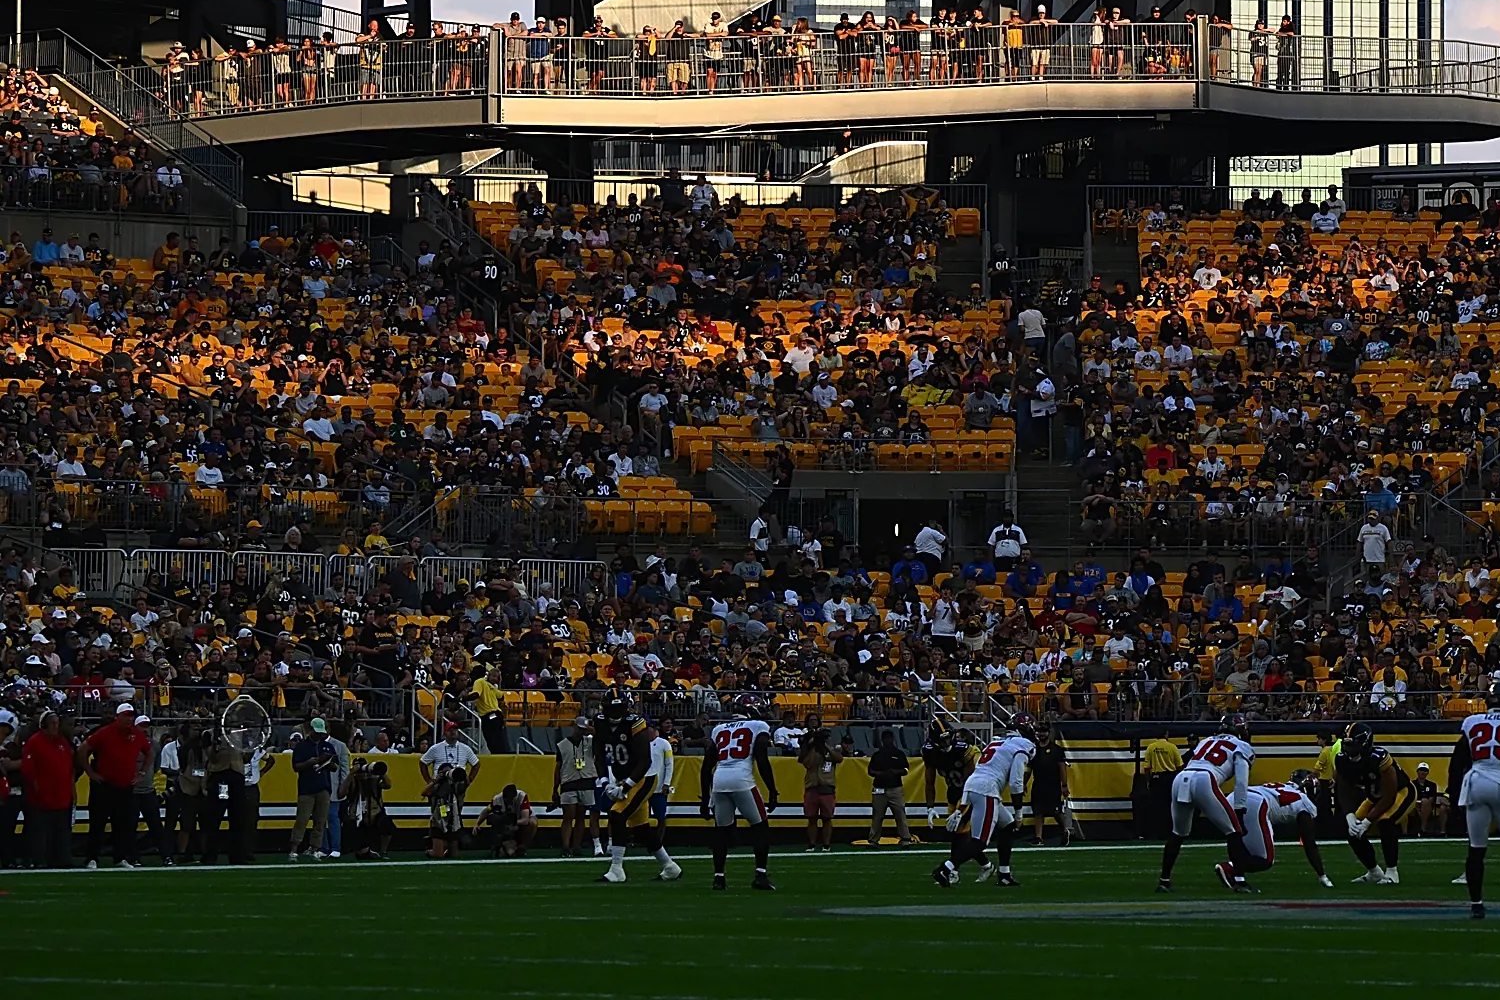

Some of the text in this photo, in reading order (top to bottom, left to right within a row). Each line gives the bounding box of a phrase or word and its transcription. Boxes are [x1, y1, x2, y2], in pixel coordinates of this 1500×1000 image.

[61, 123, 74, 131] 90
[1233, 156, 1301, 172] itizens
[86, 250, 102, 262] 90
[483, 265, 498, 279] 90
[1364, 311, 1378, 324] 90
[1417, 309, 1430, 322] 90
[464, 347, 480, 357] 90
[1261, 378, 1276, 391] 90
[724, 404, 739, 416] 86
[185, 450, 199, 463] 55
[1084, 570, 1100, 578] H2P
[550, 624, 570, 639] 90
[895, 619, 908, 632] 90
[413, 668, 428, 683] 43
[958, 664, 971, 675] 14
[1023, 669, 1038, 682] 43
[716, 728, 752, 761] 23
[1193, 740, 1238, 766] 15
